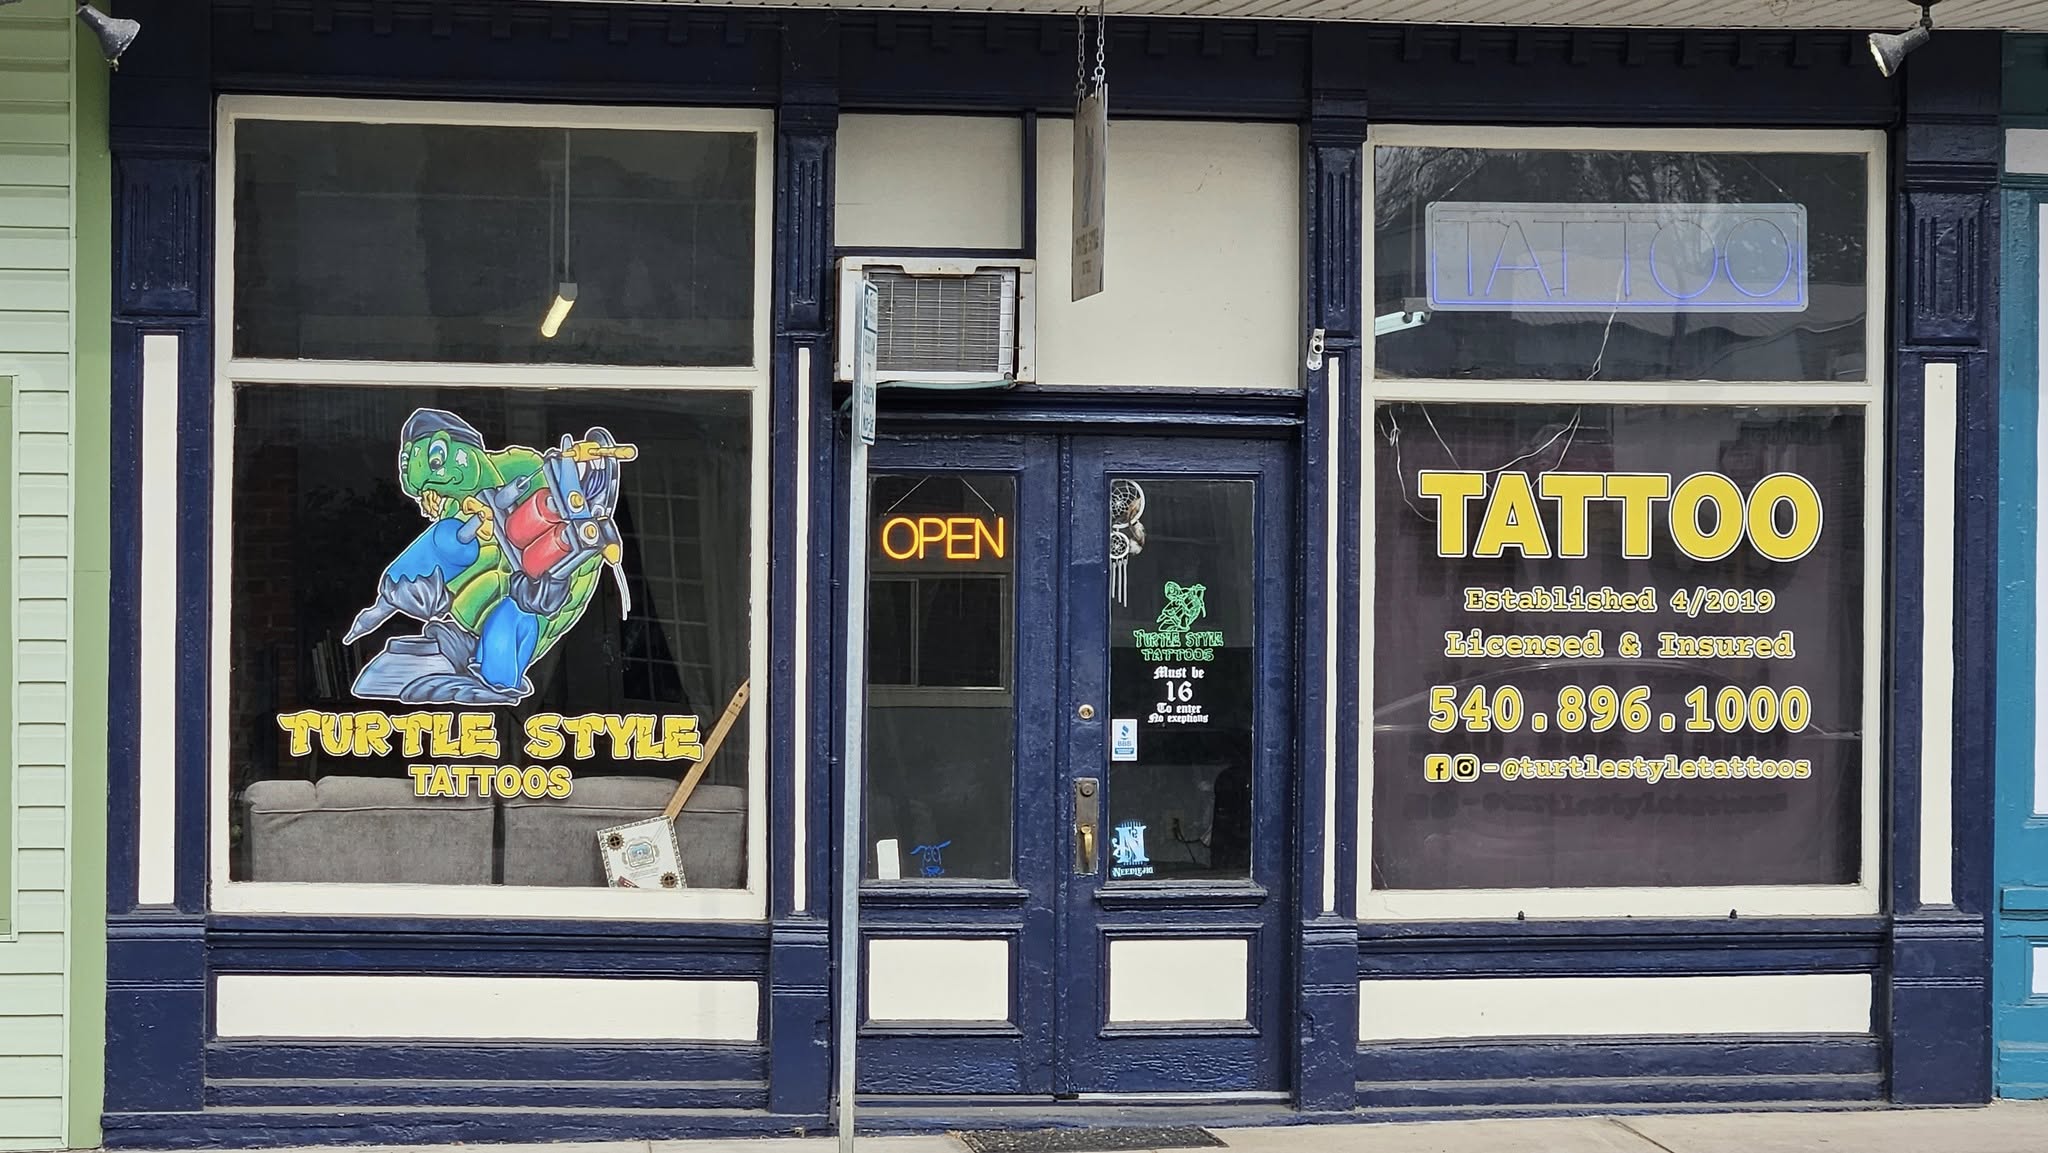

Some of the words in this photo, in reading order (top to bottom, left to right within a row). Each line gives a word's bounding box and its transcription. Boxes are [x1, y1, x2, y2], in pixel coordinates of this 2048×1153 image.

[1434, 217, 1792, 299] TATTOO
[1418, 471, 1823, 562] TATTOO
[882, 517, 1004, 559] OPEN
[1464, 586, 1657, 612] Established
[1670, 585, 1775, 617] 4/2019
[1133, 629, 1181, 648] TURTLE
[1185, 631, 1224, 647] STYLE
[1444, 628, 1604, 658] Licensed
[1618, 631, 1642, 657] &
[1658, 631, 1795, 658] Insured
[1141, 648, 1214, 661] TATTOOS
[1153, 666, 1187, 679] Must
[1191, 666, 1205, 679] be
[1166, 681, 1193, 702] 16
[1147, 712, 1164, 723] No
[1156, 702, 1173, 714] To
[1176, 703, 1202, 715] enter
[1428, 684, 1812, 733] 540.896.1000
[277, 710, 500, 758] TURTLE
[524, 713, 703, 761] STYLE
[408, 765, 573, 799] TATTOOS
